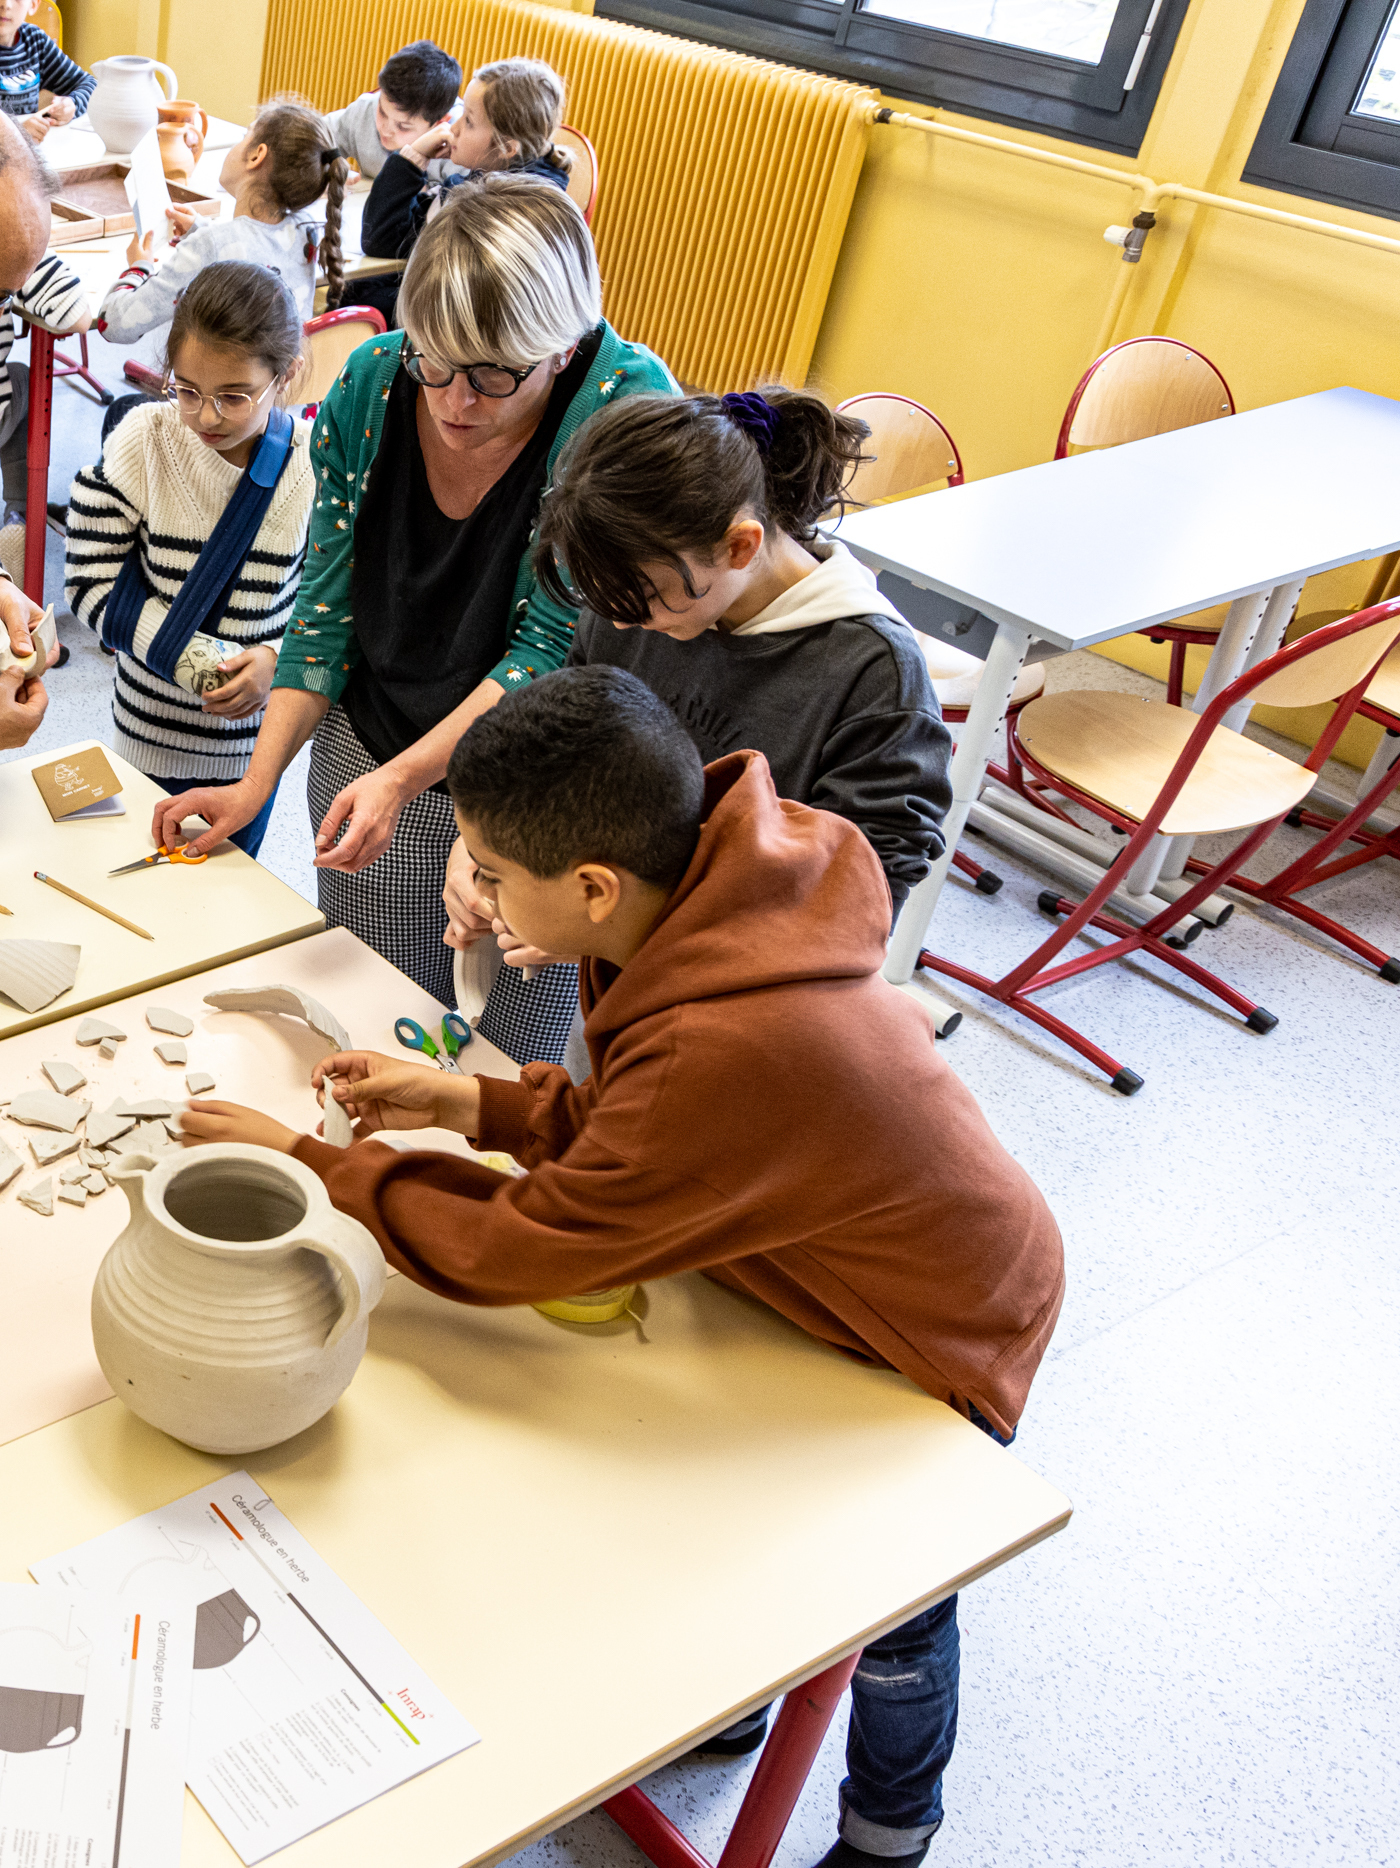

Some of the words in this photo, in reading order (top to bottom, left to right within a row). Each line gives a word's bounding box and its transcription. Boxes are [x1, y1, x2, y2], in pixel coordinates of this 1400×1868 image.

[231, 1494, 278, 1547] Céramologue
[275, 1547, 288, 1559] en
[286, 1558, 310, 1583] herbe
[152, 1620, 171, 1683] Céramologue
[153, 1685, 162, 1697] en
[396, 1687, 426, 1719] Inrap
[150, 1700, 164, 1730] herbe
